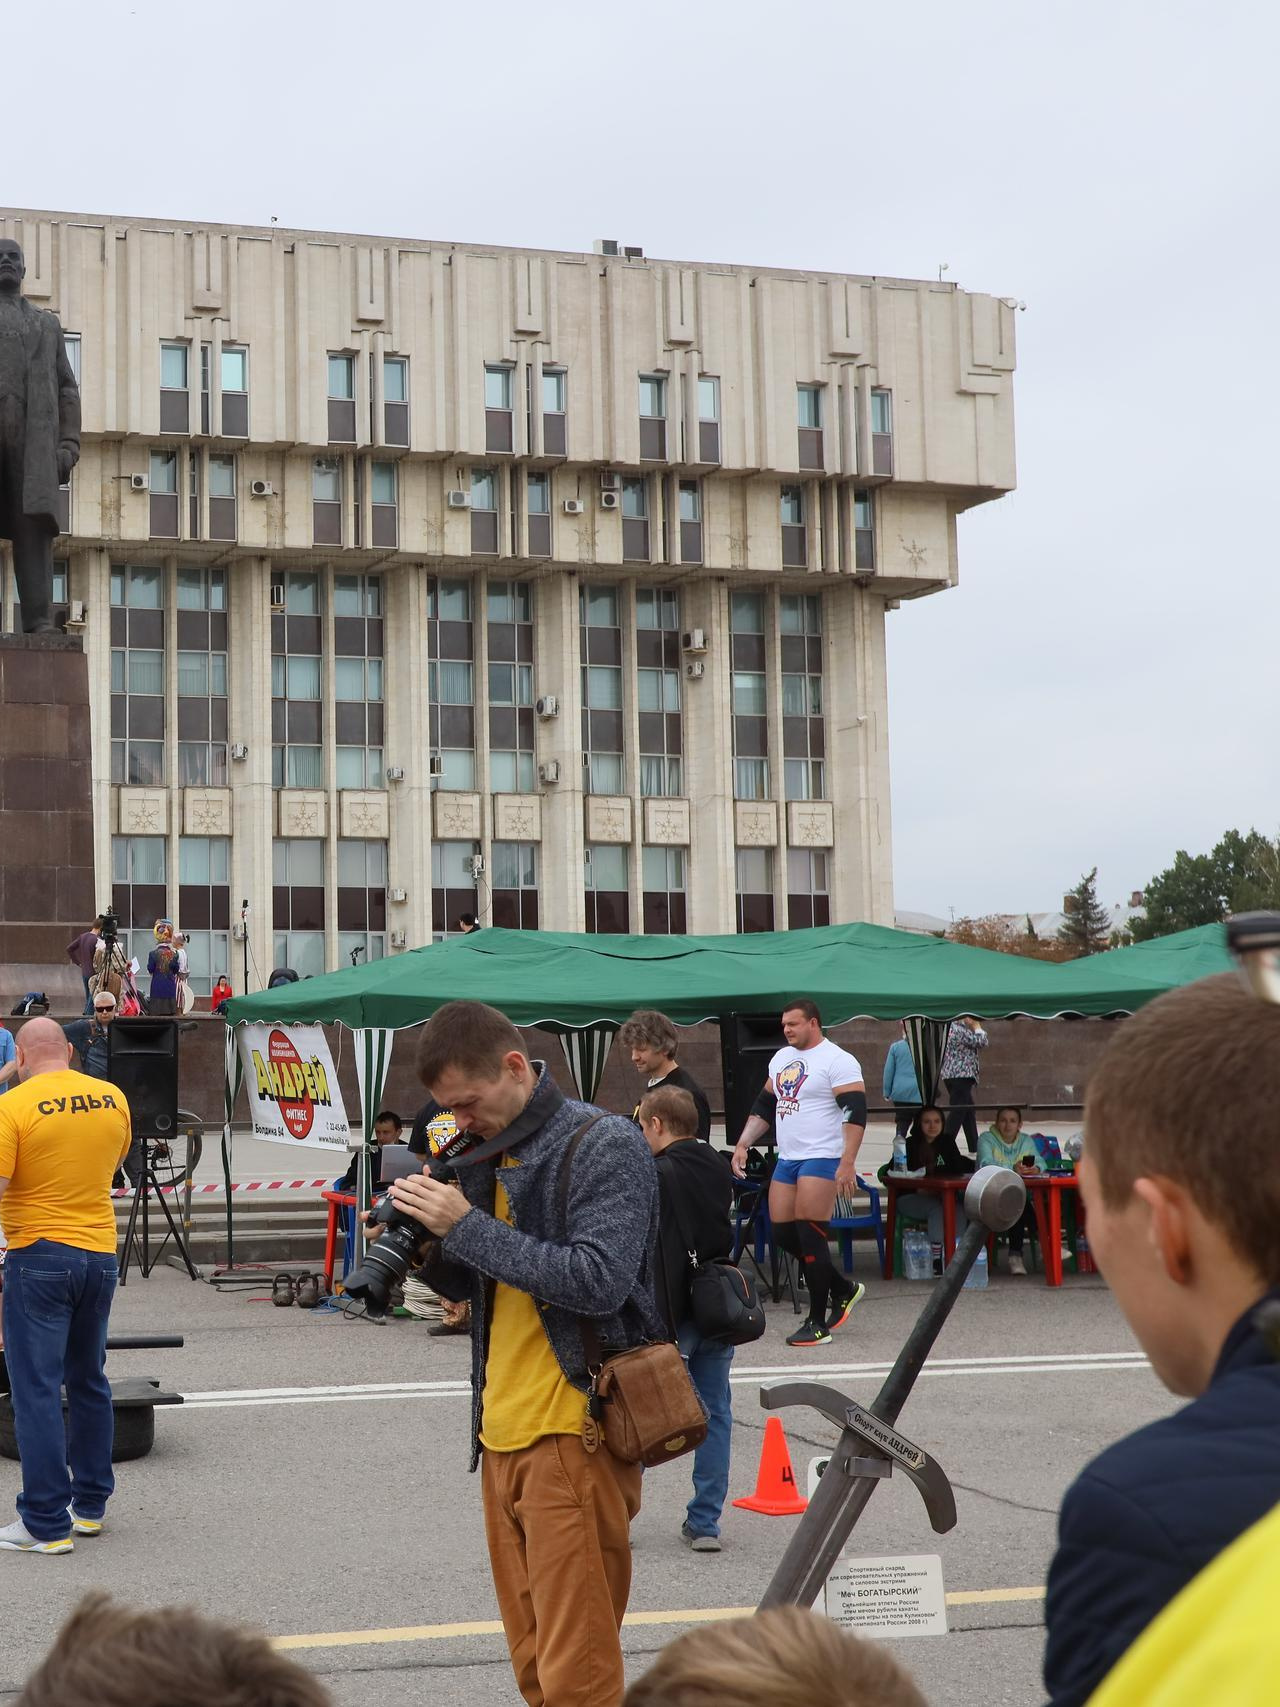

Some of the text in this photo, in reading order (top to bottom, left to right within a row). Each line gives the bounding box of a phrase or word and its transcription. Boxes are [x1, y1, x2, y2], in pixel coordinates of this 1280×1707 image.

[251, 1050, 332, 1107] АНДРЕЙ
[37, 1094, 117, 1115] СУДЬЯ
[285, 1108, 308, 1121] ФИТНЕС
[255, 1123, 277, 1137] Болдина
[854, 1413, 874, 1432] Спорт
[782, 1465, 794, 1486] 4
